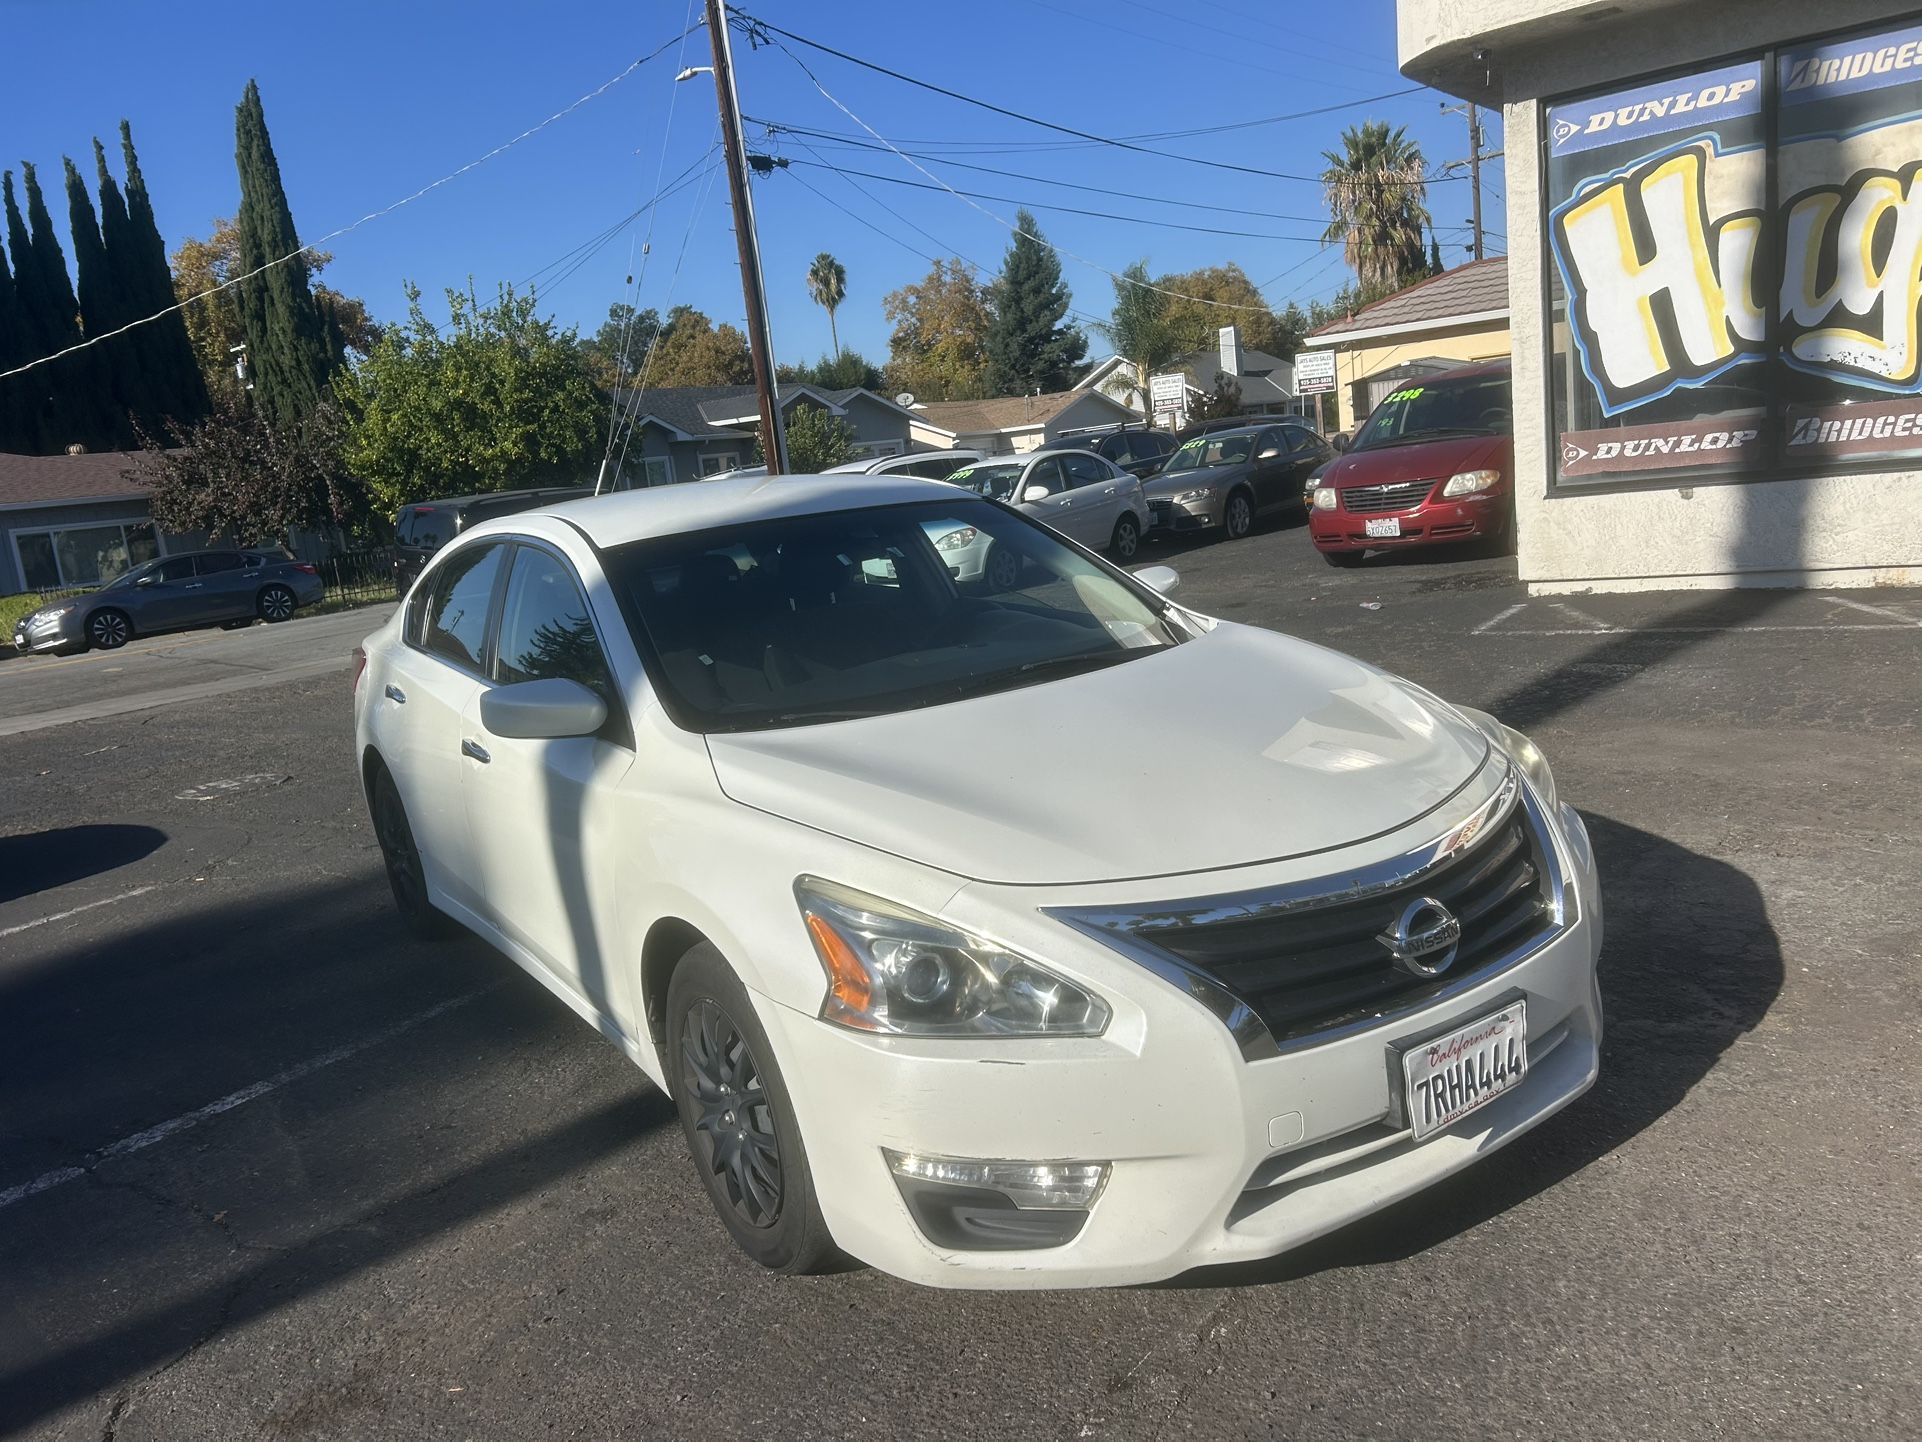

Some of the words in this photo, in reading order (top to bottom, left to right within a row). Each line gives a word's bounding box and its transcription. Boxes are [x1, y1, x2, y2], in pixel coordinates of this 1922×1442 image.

[1584, 79, 1756, 134] DUNLOP
[1592, 430, 1759, 460] DUNLOP
[1407, 922, 1459, 953] NISSAN
[1428, 1023, 1505, 1068] California
[1415, 1036, 1523, 1125] 7RHA444
